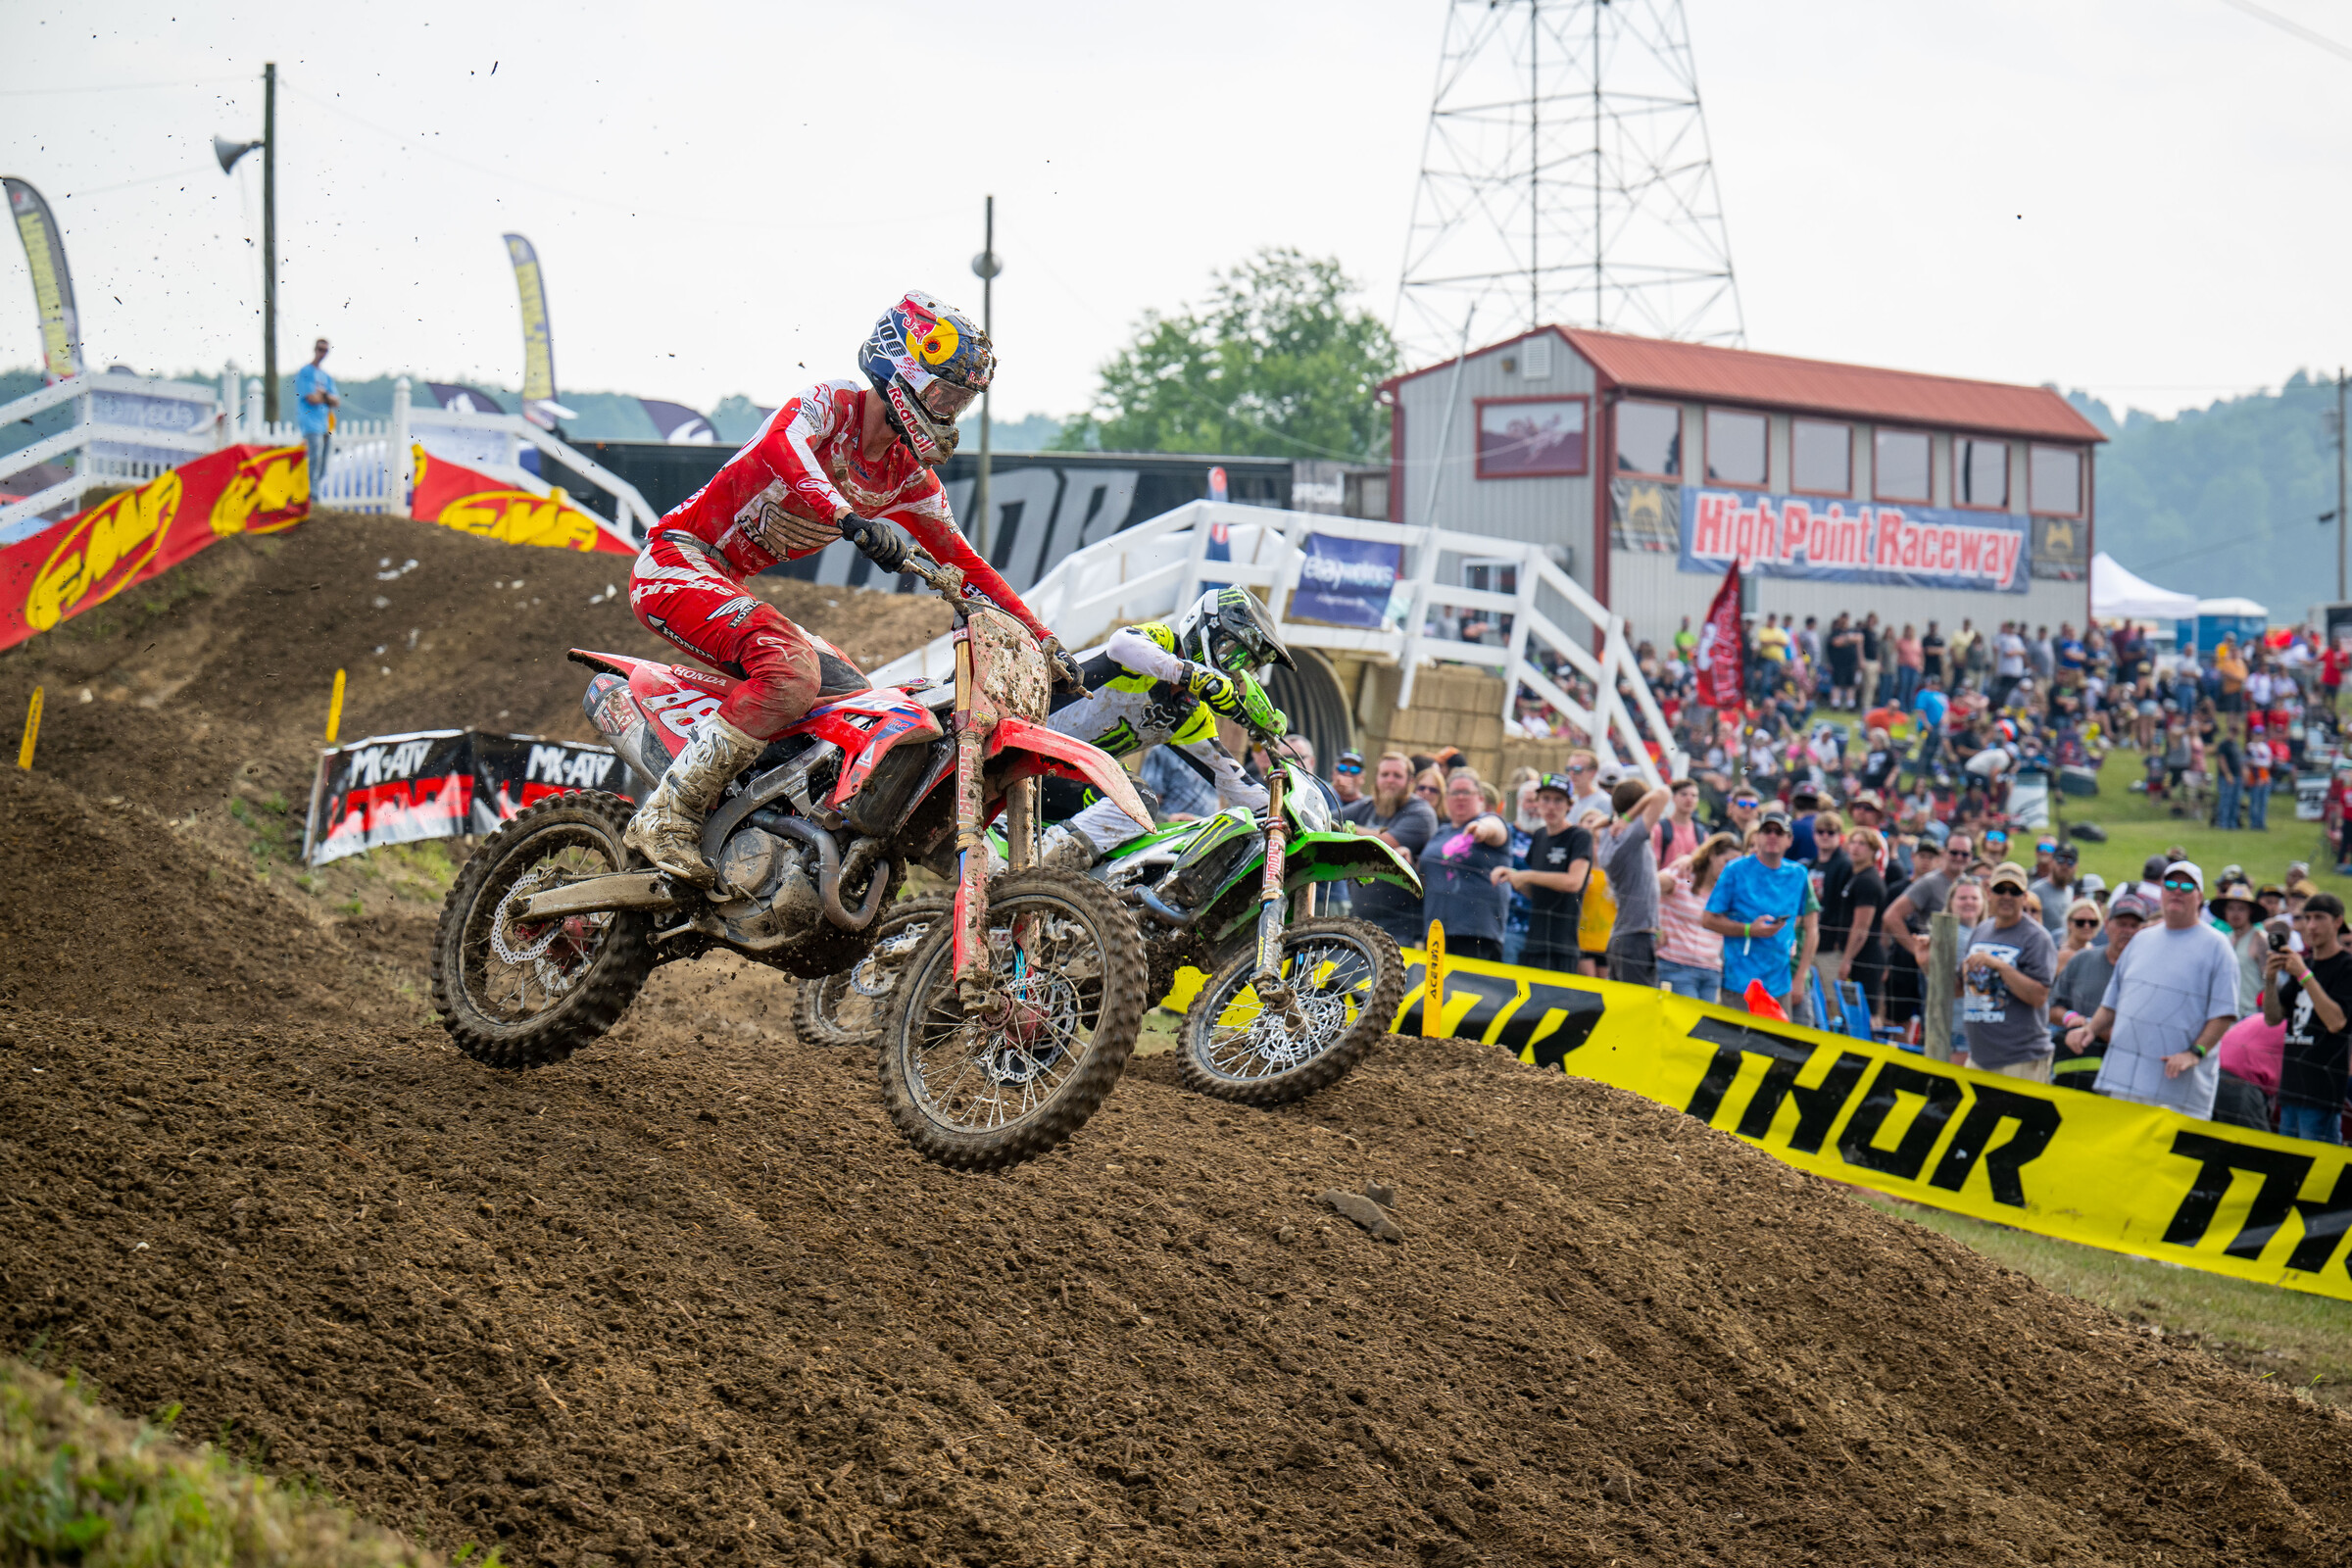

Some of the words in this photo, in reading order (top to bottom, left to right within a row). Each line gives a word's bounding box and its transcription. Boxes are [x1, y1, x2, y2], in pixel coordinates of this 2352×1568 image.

[26, 469, 181, 632] FMF
[1693, 494, 1777, 571] High
[1780, 500, 1874, 568] Point
[1875, 507, 2022, 590] Raceway
[630, 579, 735, 606] alpinetars
[662, 627, 717, 662] HONDA
[673, 666, 727, 687] HONDA
[958, 743, 977, 817] SHOWA
[1266, 839, 1282, 883] SHOWA
[1429, 940, 1440, 1000] ACERBIS
[1684, 1015, 2063, 1209] THOR
[2161, 1130, 2352, 1280] TH
